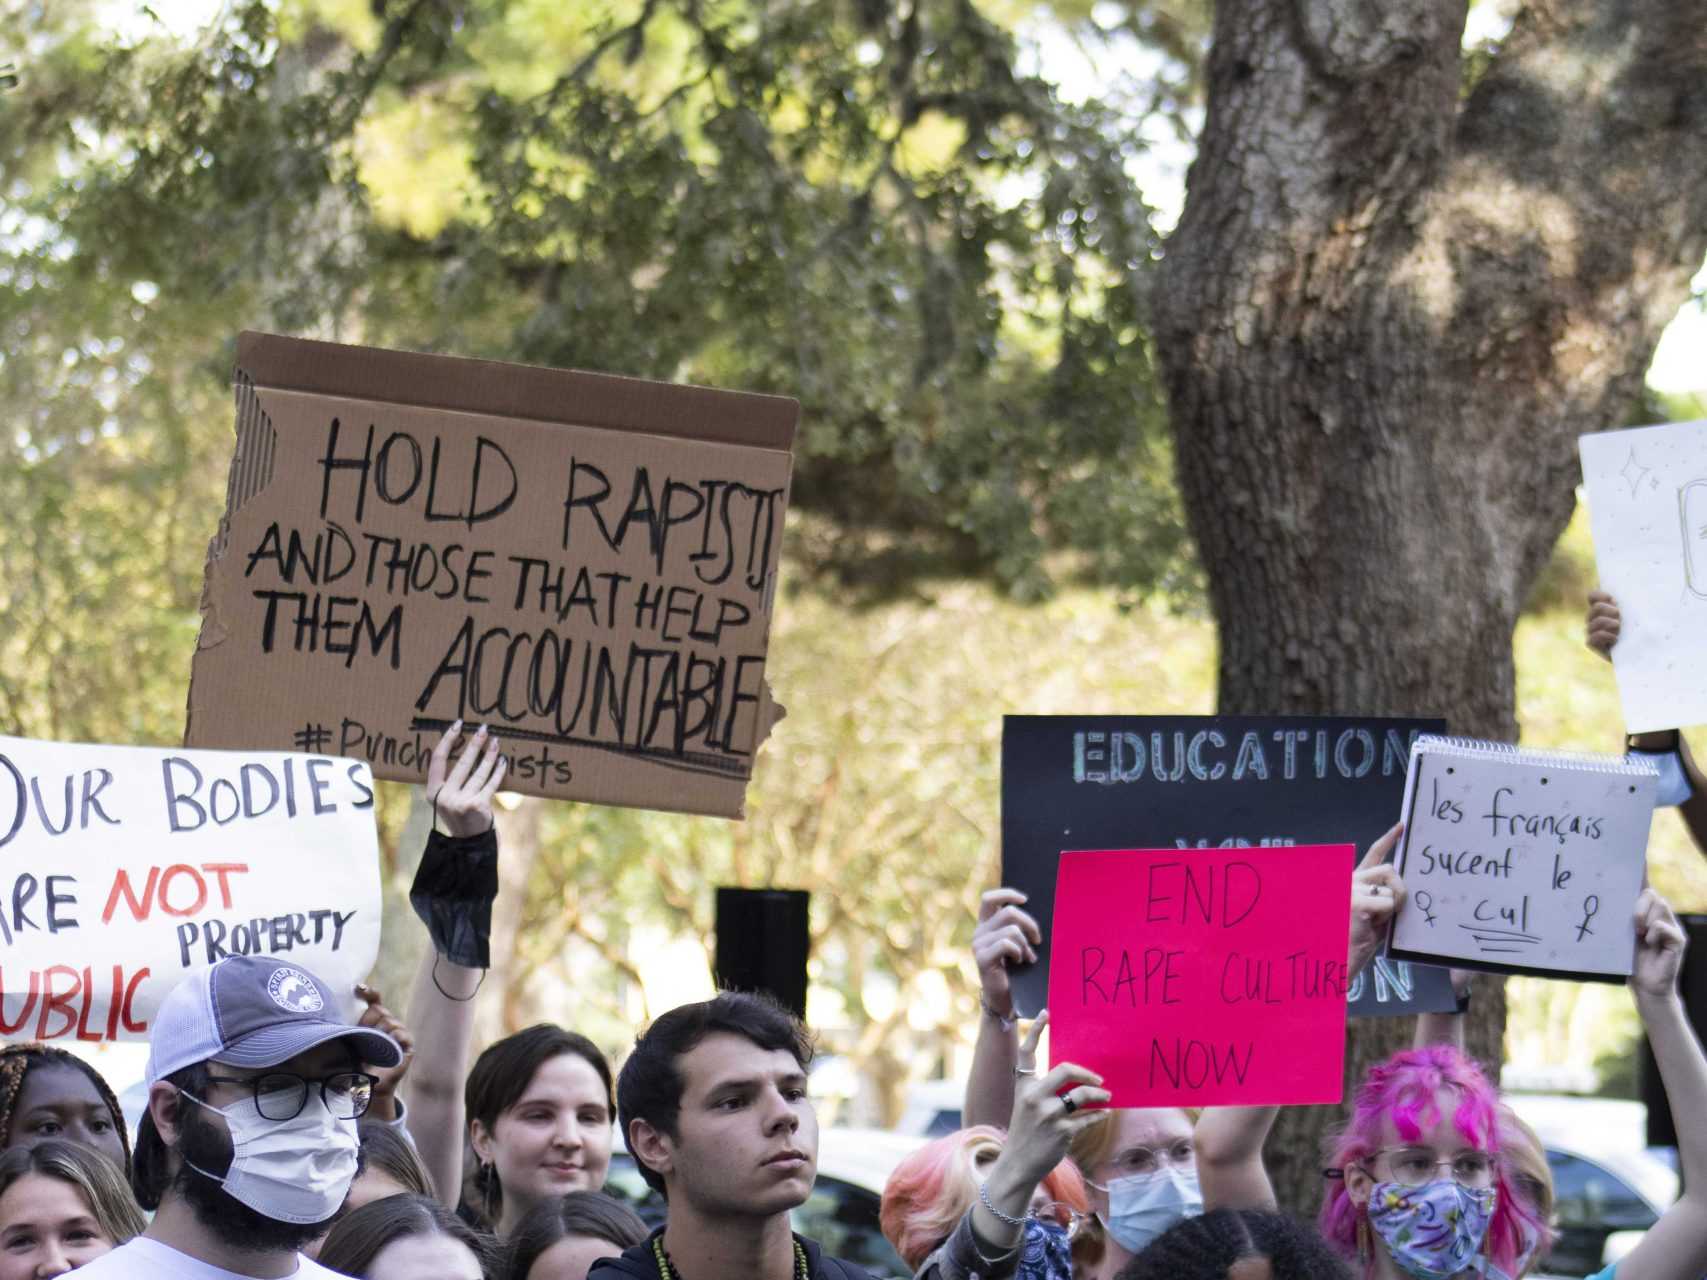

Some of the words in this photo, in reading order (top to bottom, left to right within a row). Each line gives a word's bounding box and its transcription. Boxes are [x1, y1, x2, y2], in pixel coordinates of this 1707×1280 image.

[318, 418, 517, 531] HOLD
[245, 521, 356, 584] AND
[363, 532, 495, 601] THOSE
[509, 556, 632, 630] THAT
[634, 583, 750, 647] HELP
[253, 589, 405, 669] THEM
[413, 615, 766, 756] ACCOUNTABLE
[1073, 728, 1418, 783] EDUCATION
[1431, 778, 1464, 826] les
[1482, 787, 1604, 844] français
[102, 862, 249, 925] NOT
[1145, 861, 1262, 928] END
[1551, 854, 1572, 891] le
[176, 909, 357, 968] PROPERTY
[1081, 946, 1185, 1008] RAPE
[1220, 950, 1348, 1004] CULTURE
[1148, 1037, 1254, 1090] NOW
